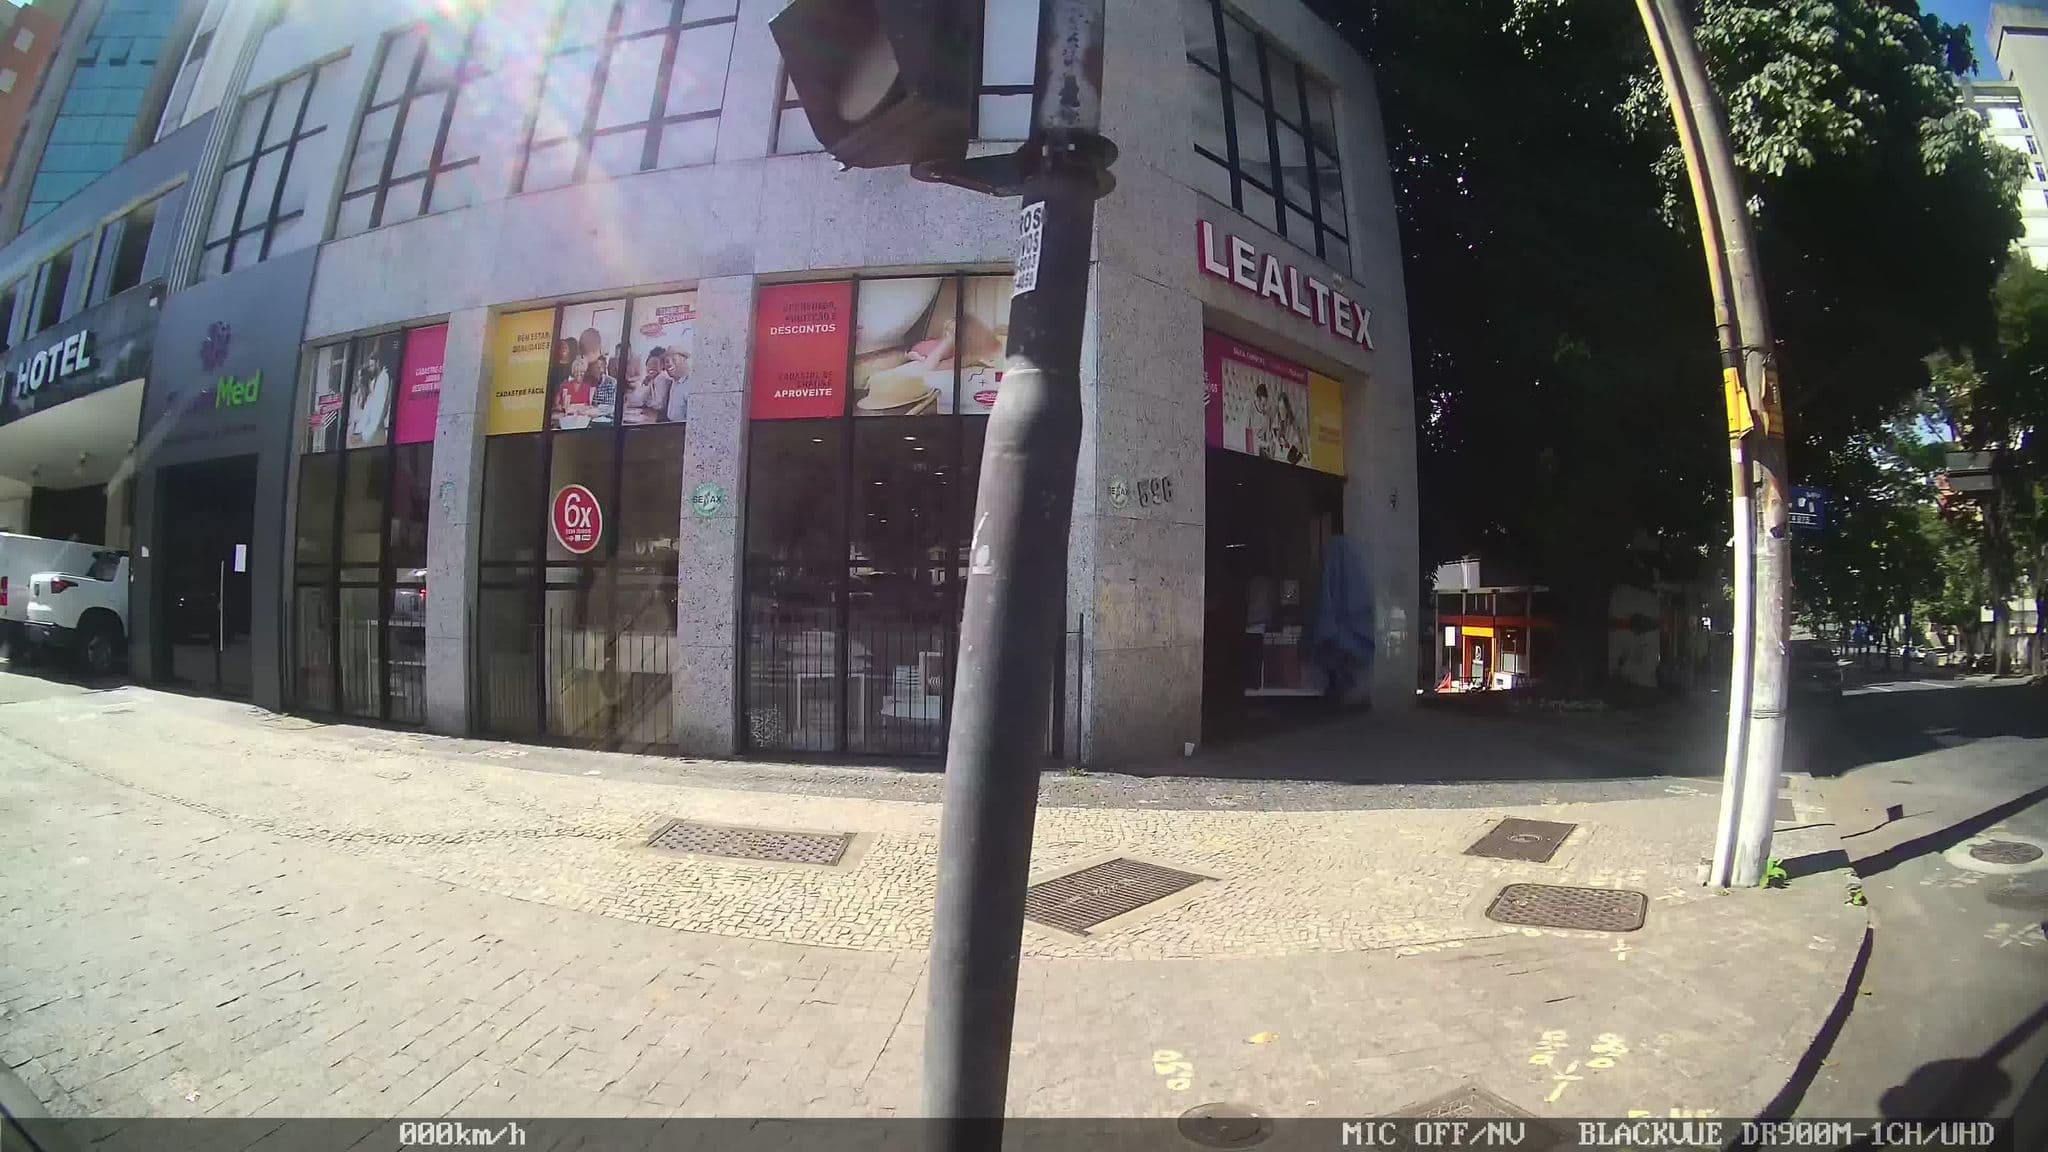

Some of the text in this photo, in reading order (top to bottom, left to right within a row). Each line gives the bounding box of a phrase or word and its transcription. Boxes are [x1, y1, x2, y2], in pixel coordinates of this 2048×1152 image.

[1197, 219, 1375, 350] LEALTEX
[770, 323, 836, 336] DESCONTOS
[15, 329, 90, 398] HOTEL
[216, 368, 261, 409] Med
[774, 388, 833, 399] APROVEITE
[564, 493, 592, 528] 6x
